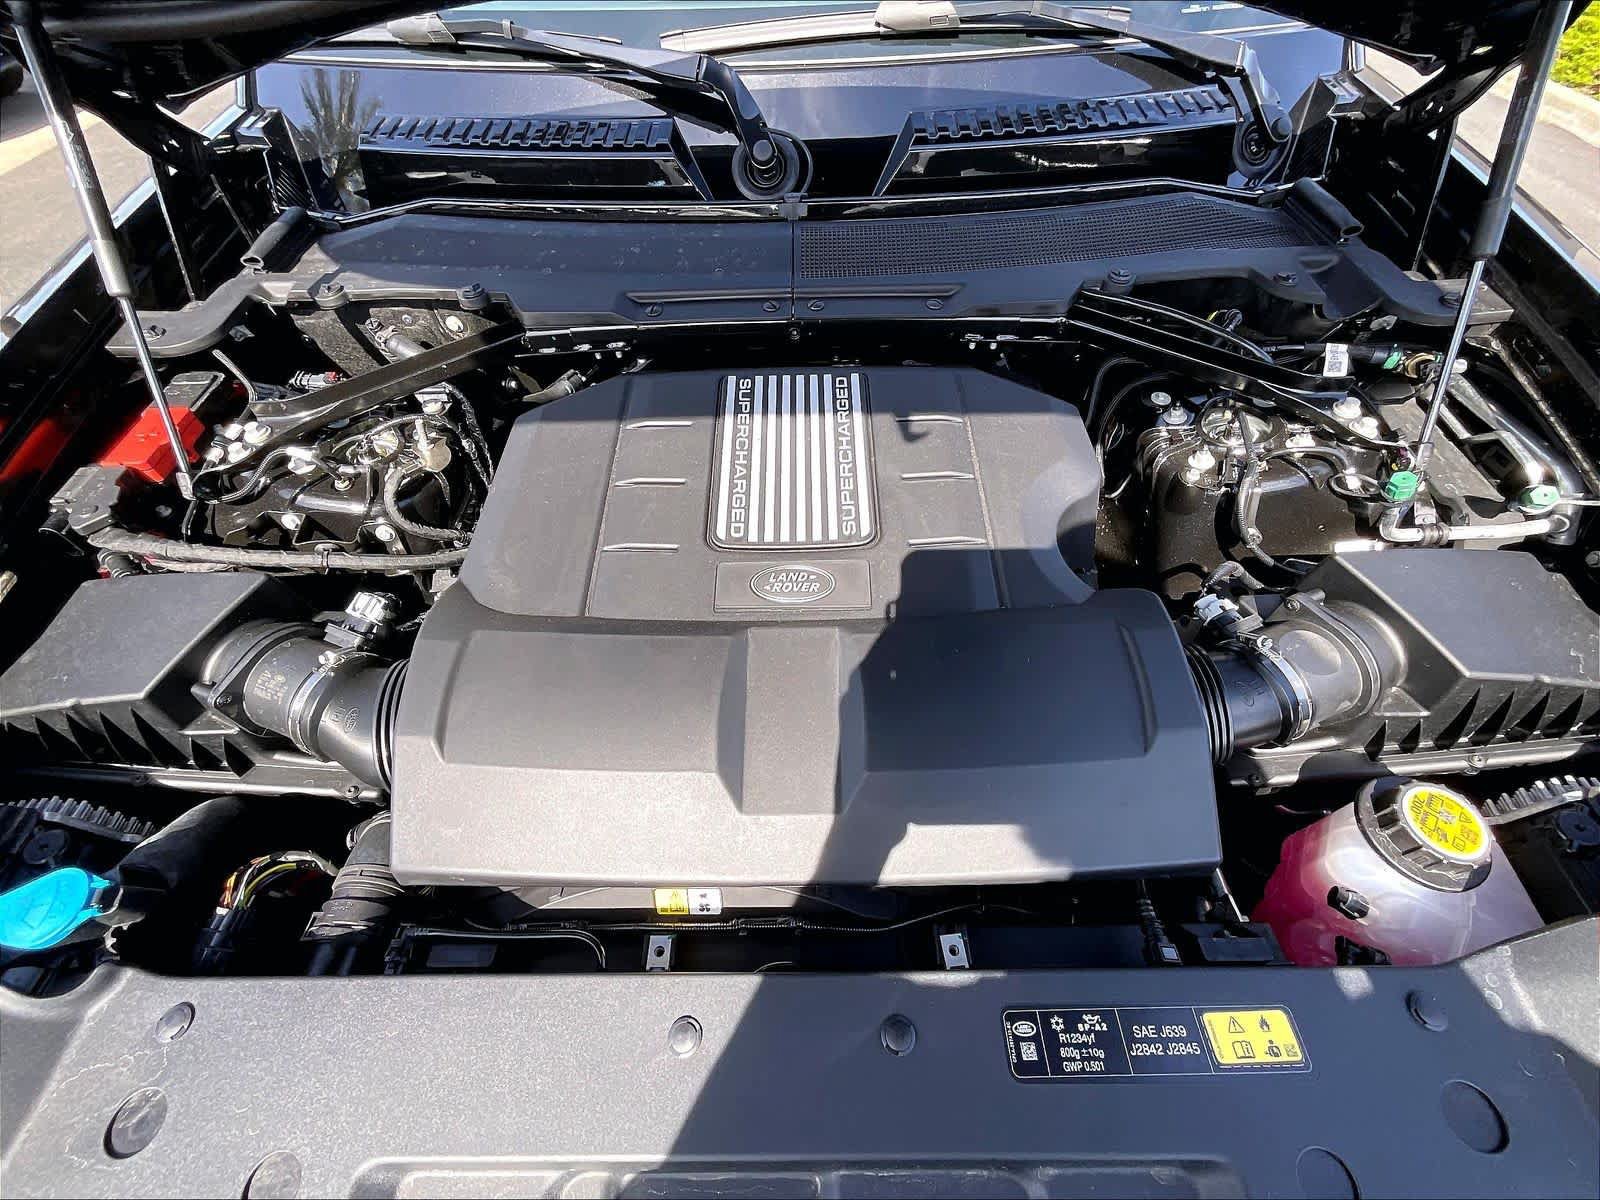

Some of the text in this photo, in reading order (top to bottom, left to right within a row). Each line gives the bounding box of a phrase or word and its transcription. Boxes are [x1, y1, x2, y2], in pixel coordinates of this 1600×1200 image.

[730, 378, 752, 538] SUPERCHARGED
[835, 376, 857, 536] SUPERCHARGED
[768, 572, 808, 583] LAND
[771, 582, 821, 593] ROVER
[1132, 1024, 1187, 1038] SAE J639
[1059, 1033, 1096, 1045] R1234yf
[1060, 1047, 1080, 1060] 800g
[1130, 1042, 1201, 1056] J2842 J2845
[1063, 1061, 1105, 1072] GWP 0.501
